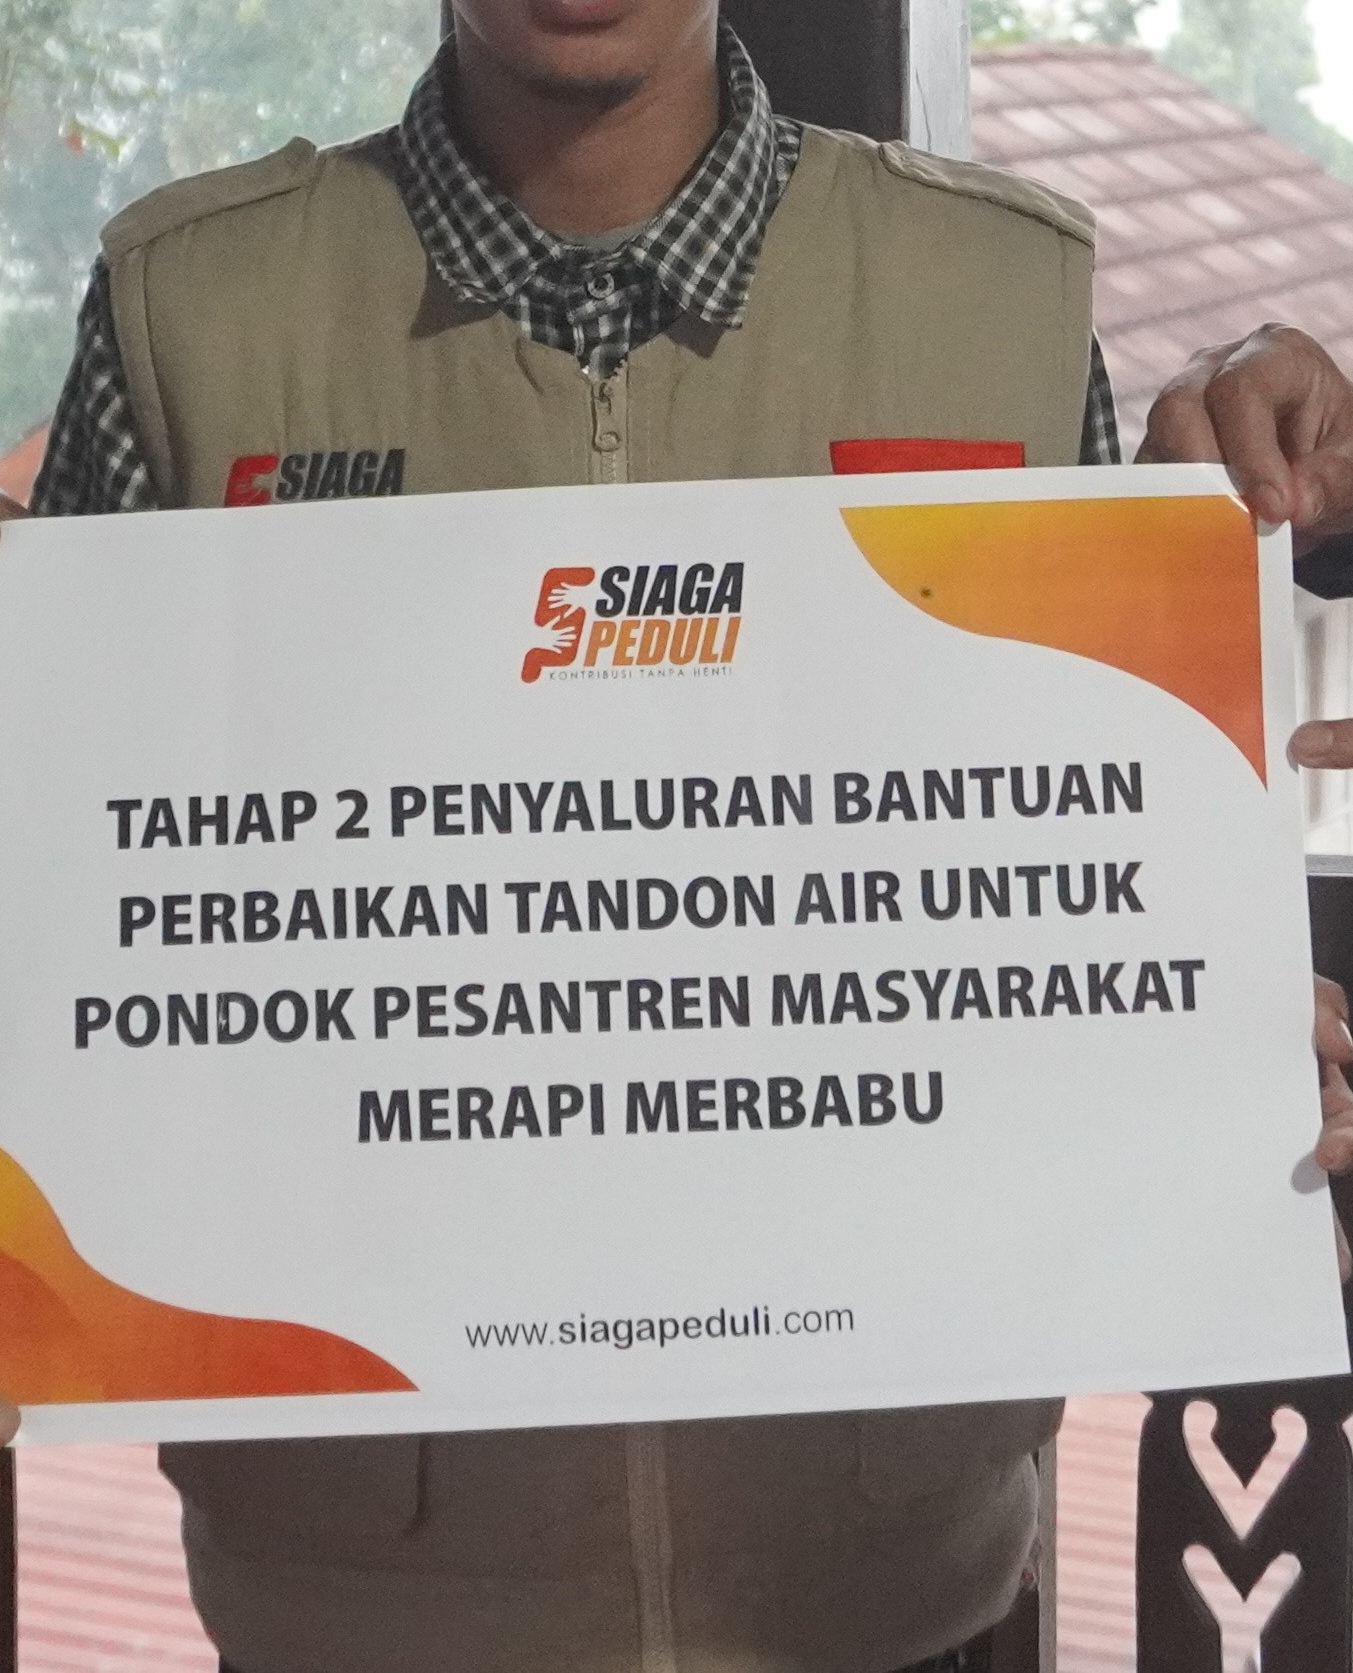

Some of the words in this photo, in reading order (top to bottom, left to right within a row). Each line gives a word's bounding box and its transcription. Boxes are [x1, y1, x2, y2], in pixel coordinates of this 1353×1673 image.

[276, 448, 406, 500] SIAGA
[595, 562, 744, 618] SIAGA
[583, 616, 742, 667] PEDULI
[549, 669, 633, 681] KONTRIBUSI
[107, 791, 317, 849] TAHAP
[336, 790, 369, 839] 2
[391, 774, 814, 837] PENYALURAN
[834, 762, 1144, 823] BANTUAN
[120, 884, 487, 947] PERBAIKAN
[505, 875, 775, 933] TANDON
[795, 871, 902, 924] AIR
[921, 862, 1145, 920] UNTUK
[76, 988, 355, 1049] PONDOK
[374, 976, 751, 1039] PESANTREN
[770, 960, 1205, 1026] MASYARAKAT
[357, 1084, 604, 1143] MERAPI
[624, 1072, 945, 1133] MERBABU
[465, 1305, 854, 1349] www.siagapeduli.com
